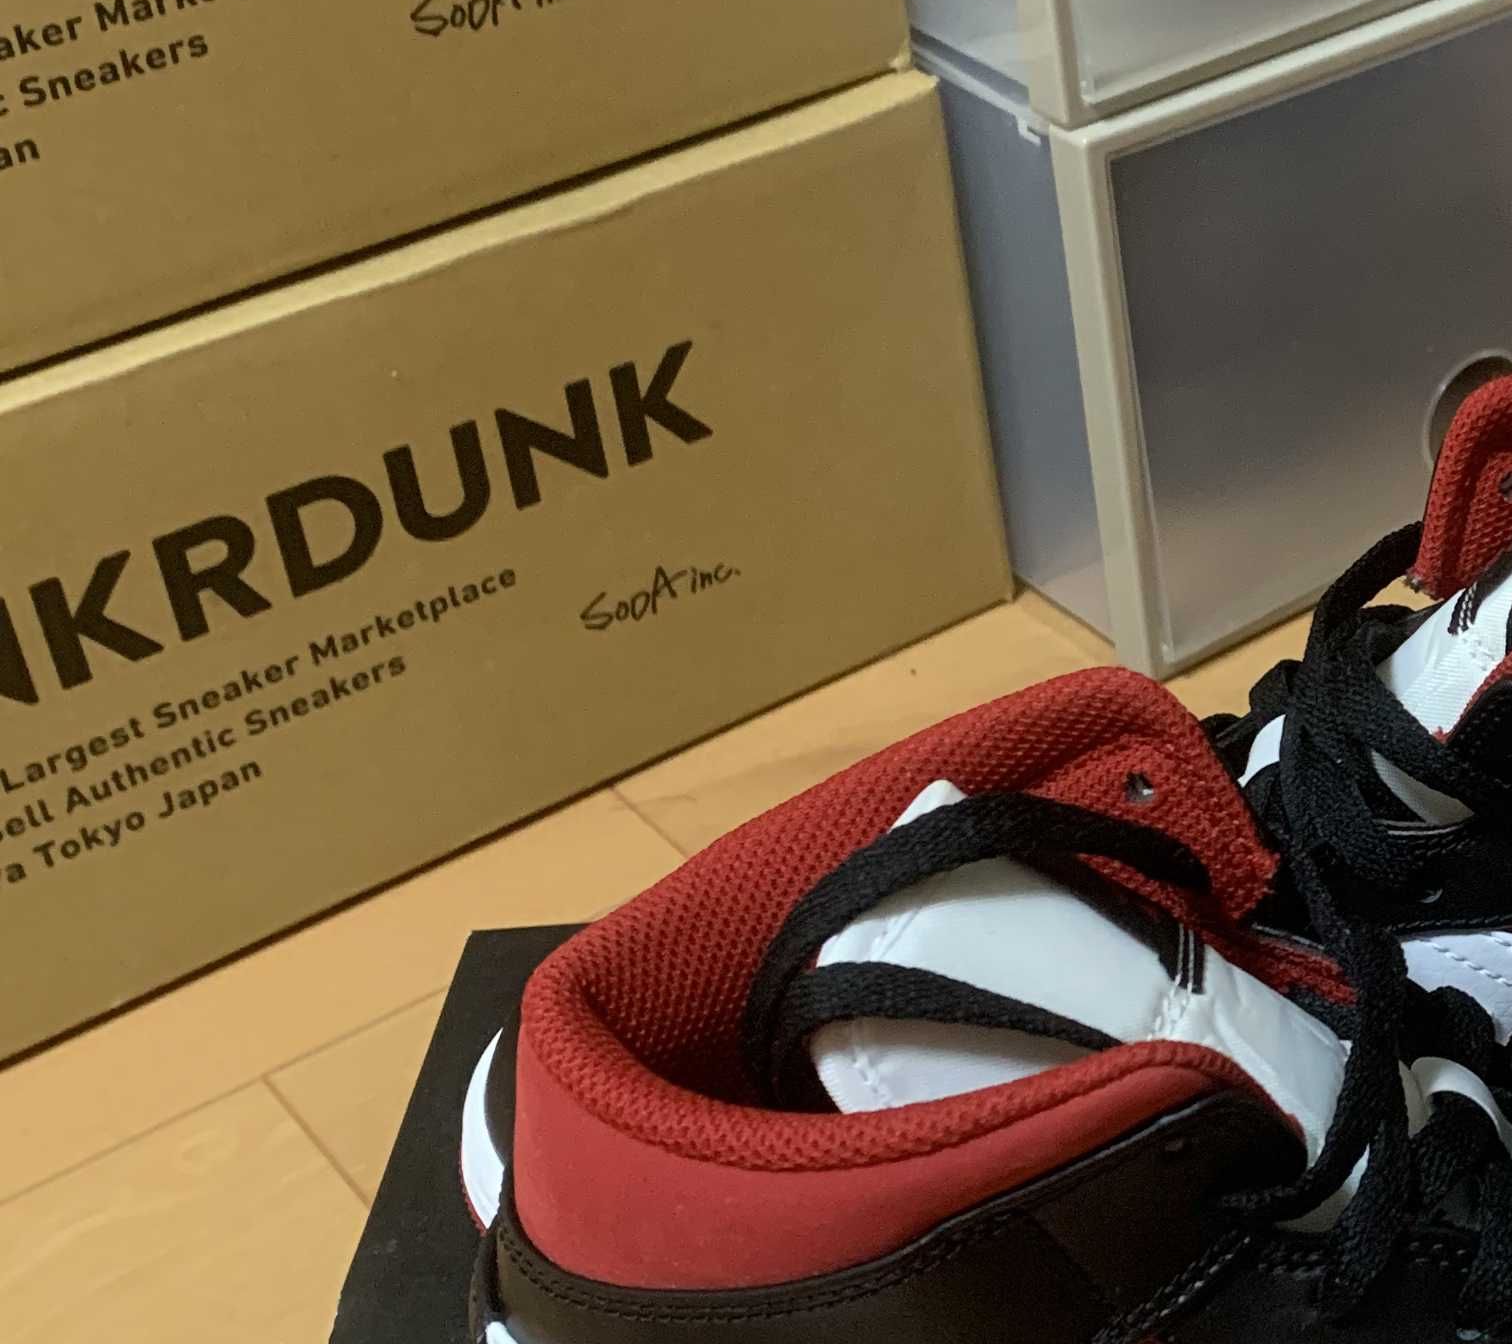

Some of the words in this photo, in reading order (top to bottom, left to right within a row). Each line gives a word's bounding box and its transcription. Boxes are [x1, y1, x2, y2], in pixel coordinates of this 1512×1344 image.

[19, 33, 209, 108] Sneakers
[0, 716, 146, 794] Largest
[152, 654, 300, 730] Sneaker
[308, 568, 518, 667] Marketplace
[0, 798, 55, 841] ell
[66, 726, 237, 815] Authentic
[244, 654, 408, 737] Sneakers
[33, 809, 146, 868] Tokyo
[158, 759, 263, 819] Japan
